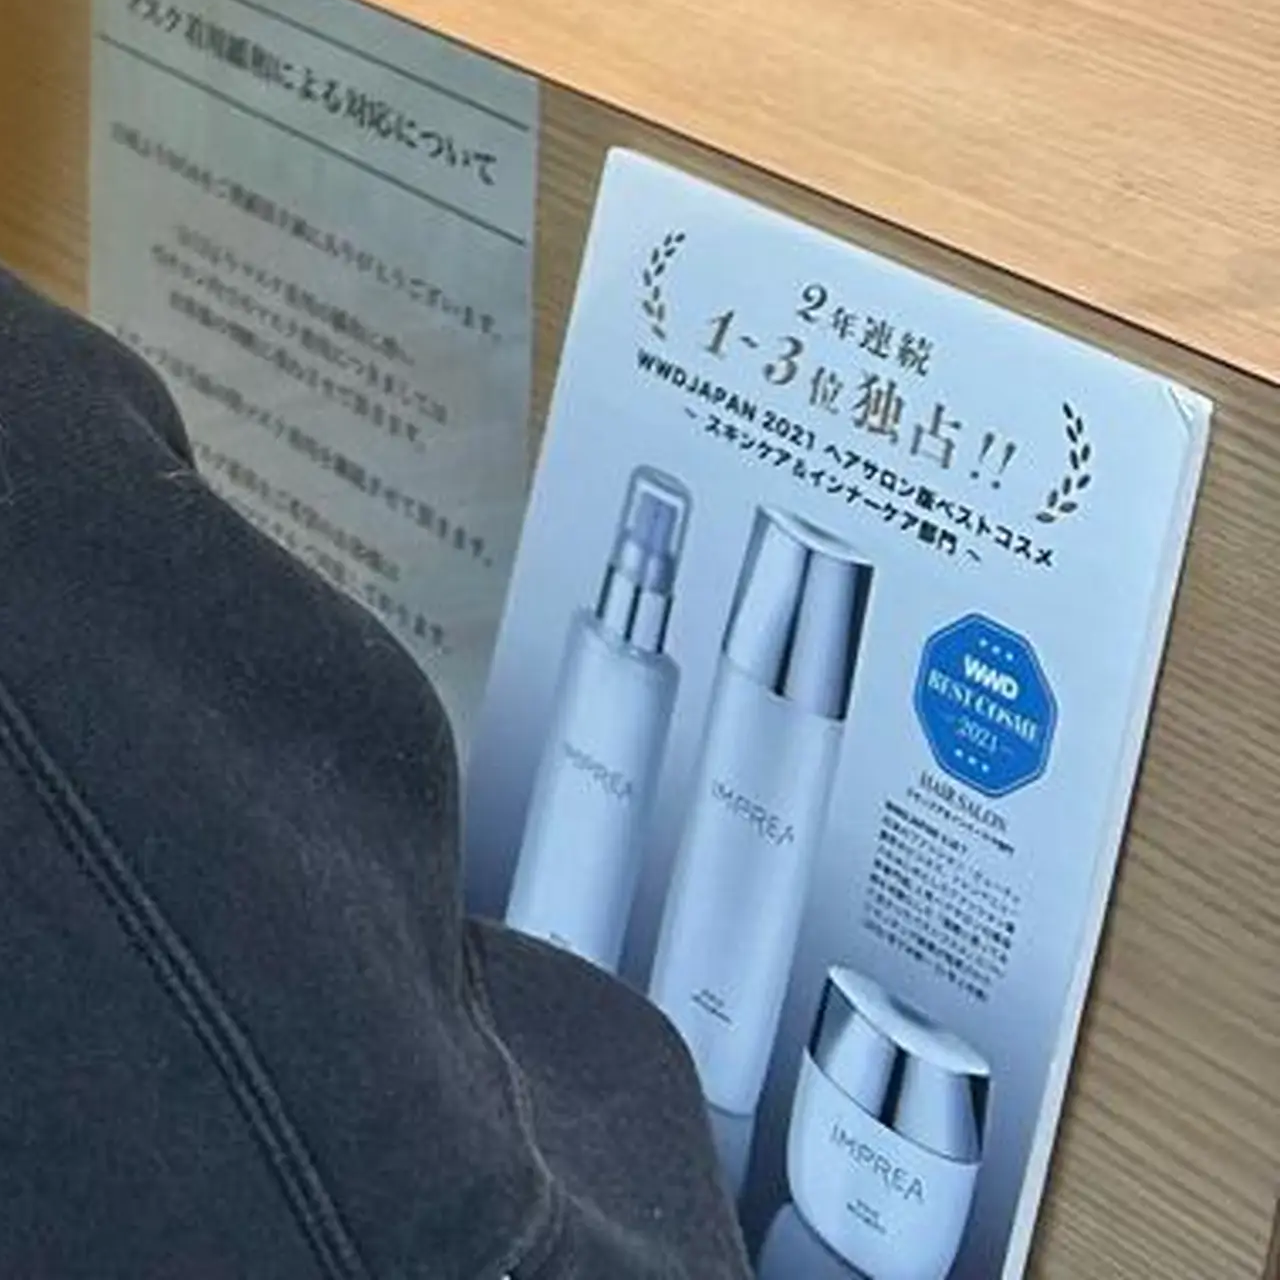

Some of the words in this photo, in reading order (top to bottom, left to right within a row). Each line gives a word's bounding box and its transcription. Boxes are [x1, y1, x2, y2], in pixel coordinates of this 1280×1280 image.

[796, 283, 933, 377] 2年連続
[638, 348, 757, 422] WWDJAPAN
[761, 410, 816, 451] 2021
[963, 653, 1019, 700] WWD
